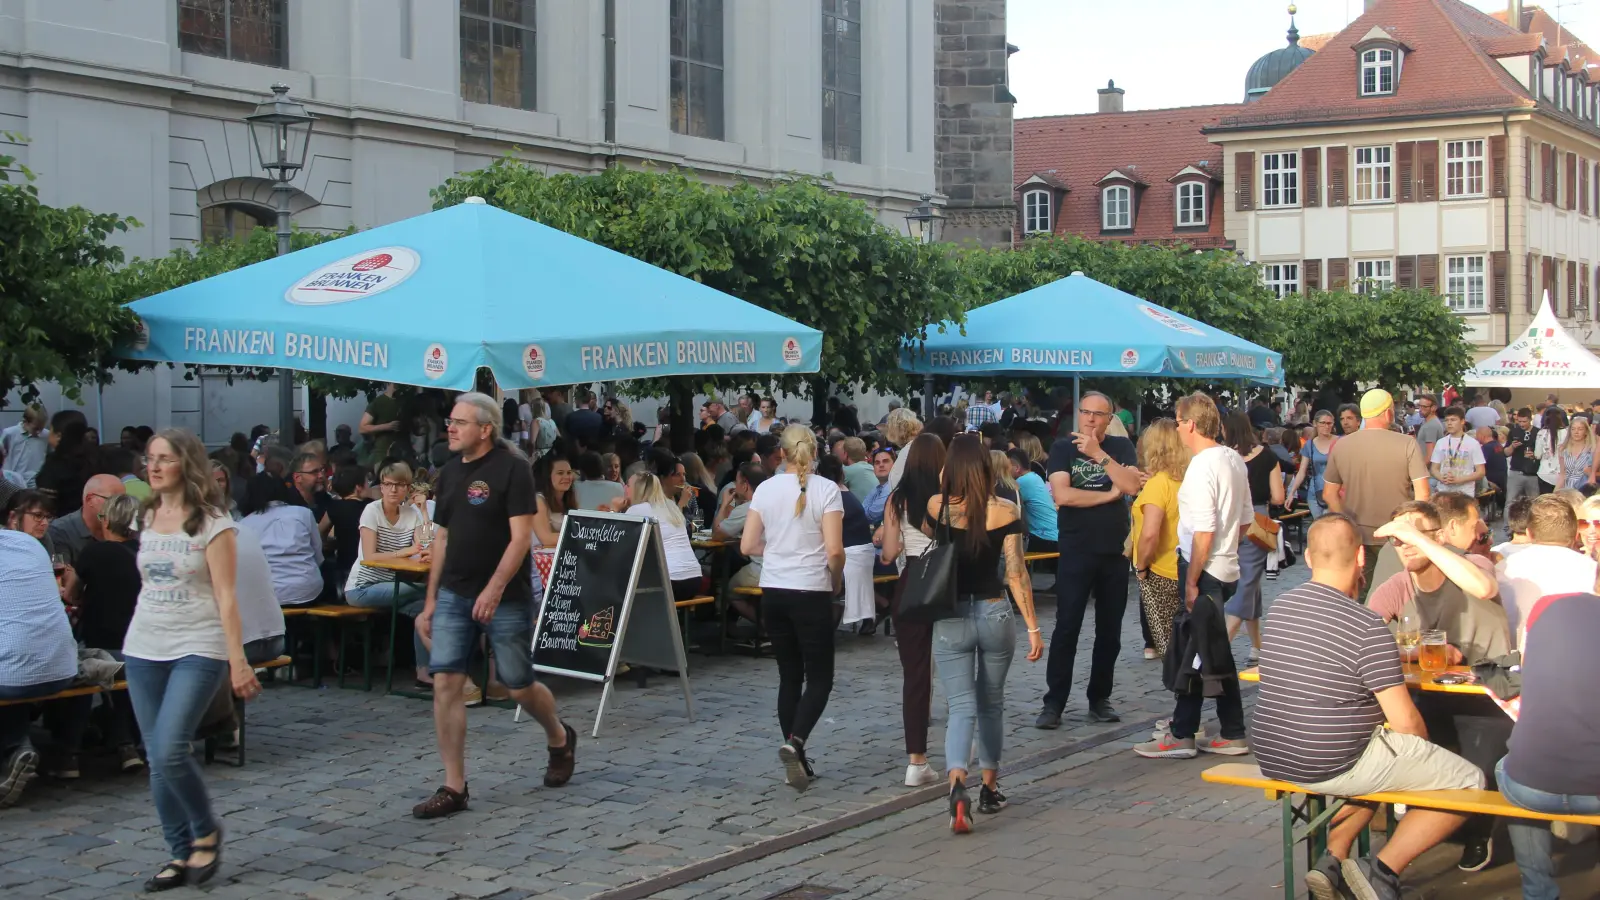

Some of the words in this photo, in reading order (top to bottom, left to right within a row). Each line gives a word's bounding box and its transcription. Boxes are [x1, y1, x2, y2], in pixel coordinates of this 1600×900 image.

[305, 280, 376, 290] BRUNNEN
[317, 272, 388, 283] FRANKEN
[184, 327, 275, 355] FRANKEN
[285, 332, 389, 369] BRUNNEN
[581, 341, 669, 371] FRANKEN
[677, 340, 756, 365] BRUNNEN
[930, 348, 1005, 367] FRANKEN
[1011, 348, 1092, 366] BRUNNEN
[1195, 351, 1228, 367] FRANKEN
[1230, 352, 1257, 369] BRUNNEN
[1071, 464, 1092, 475] Hard
[585, 541, 598, 551] mit
[562, 550, 577, 566] Käse
[560, 565, 577, 581] Wurst
[554, 579, 582, 597] Schinken
[551, 594, 572, 610] Oliven
[551, 620, 577, 634] Tomaten
[540, 631, 577, 651] Bauernbrot
